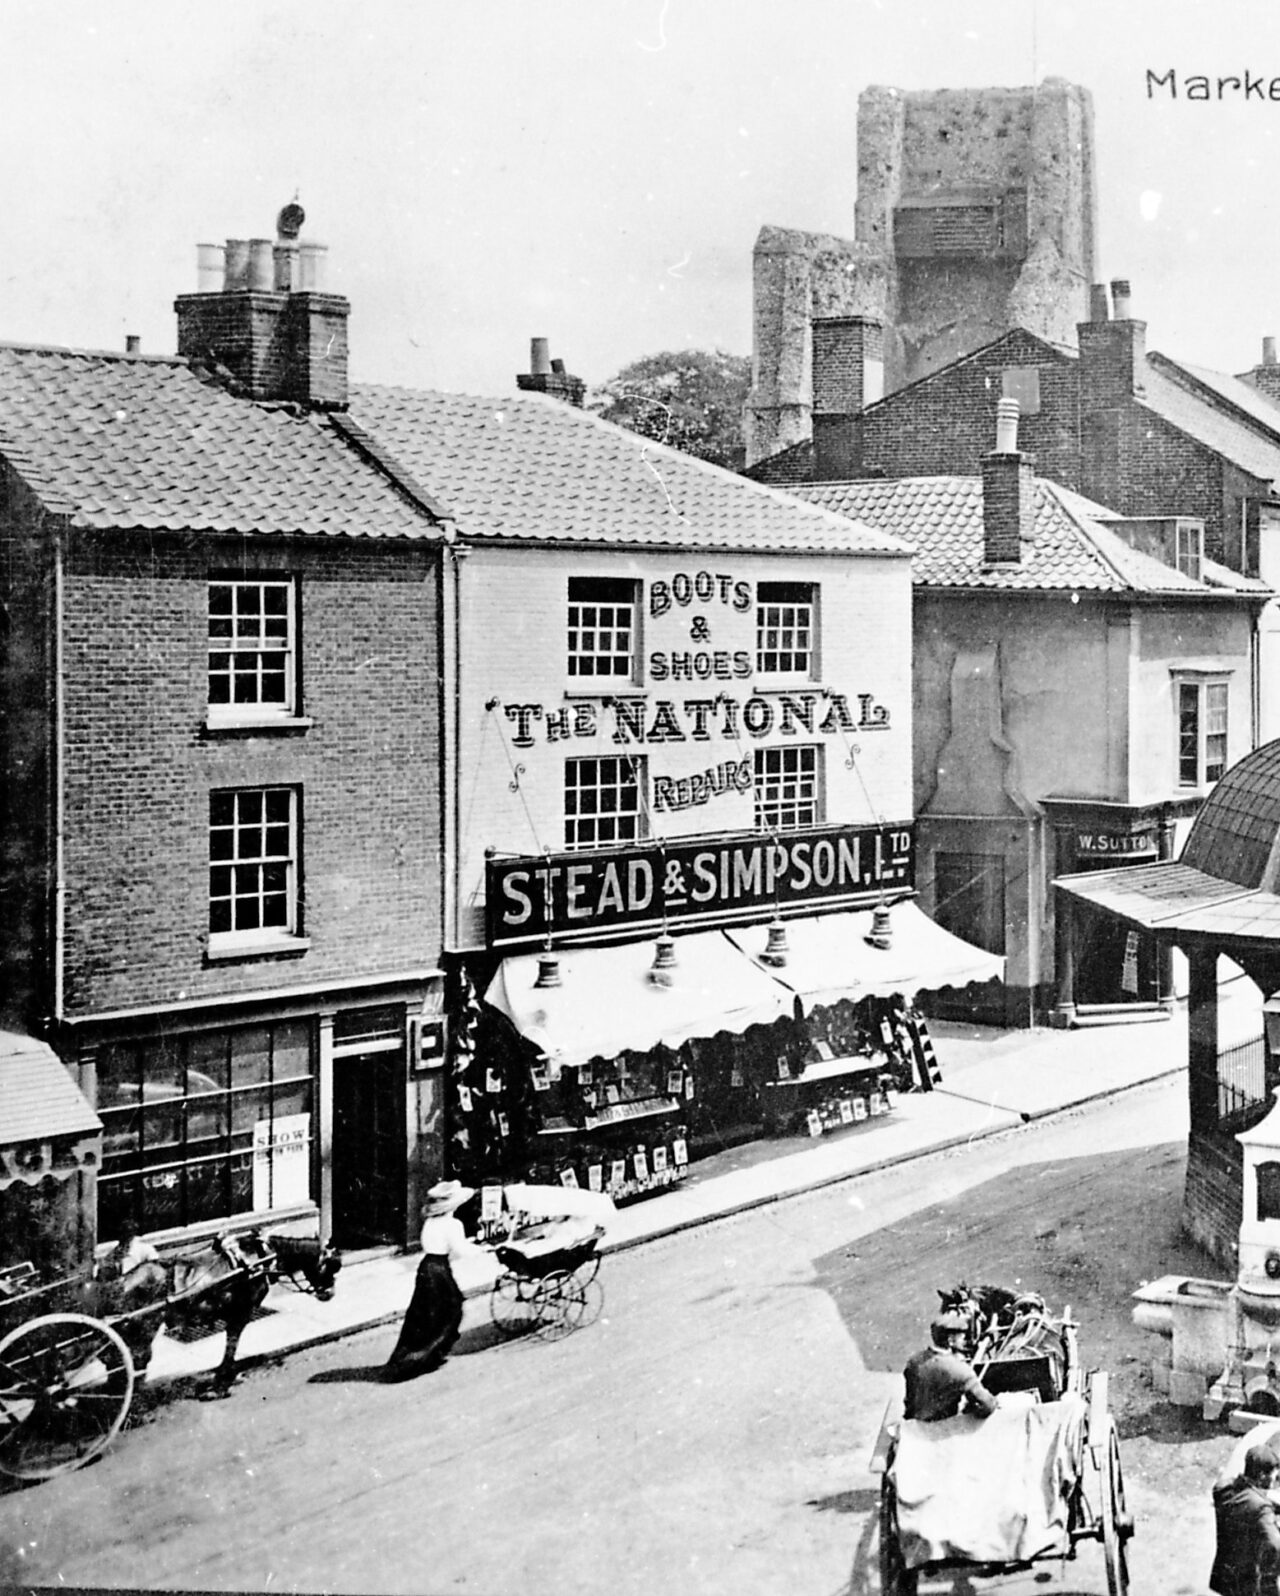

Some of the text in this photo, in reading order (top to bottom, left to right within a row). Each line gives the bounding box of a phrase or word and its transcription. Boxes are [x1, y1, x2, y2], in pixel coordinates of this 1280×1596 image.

[649, 571, 752, 617] BOOTS
[689, 614, 712, 644] &
[649, 650, 753, 681] SHOES
[503, 693, 890, 748] THE NATIONAL
[652, 758, 753, 813] REPAIRS
[502, 859, 654, 925] STEAD
[664, 859, 688, 896] &
